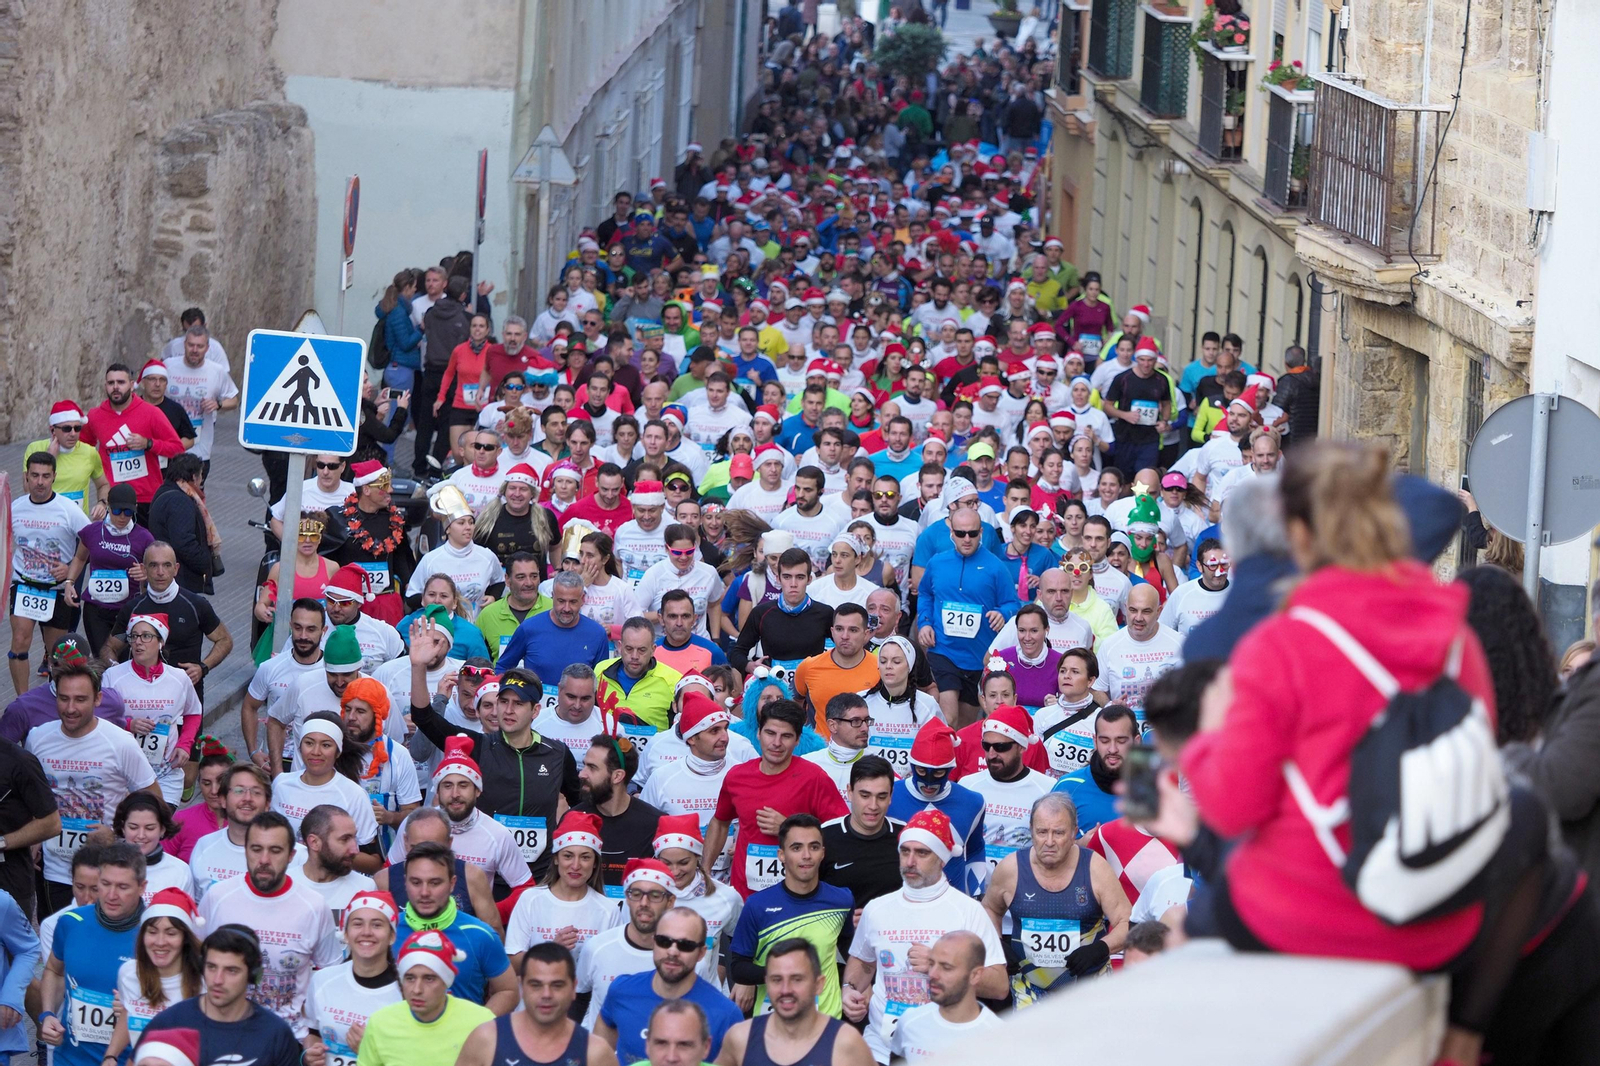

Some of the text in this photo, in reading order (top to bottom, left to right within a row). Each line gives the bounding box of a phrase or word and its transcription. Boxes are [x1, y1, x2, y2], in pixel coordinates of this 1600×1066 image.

[117, 458, 140, 472] 709
[95, 580, 122, 592] 329
[22, 596, 48, 611] 638
[946, 612, 974, 627] 216
[506, 678, 526, 688] UFC
[134, 733, 159, 750] 13
[878, 749, 908, 765] 493
[1055, 743, 1088, 763] 336
[996, 804, 1030, 814] SILVEST
[509, 829, 538, 848] 08
[1031, 934, 1070, 952] 340
[78, 1005, 117, 1029] 104
